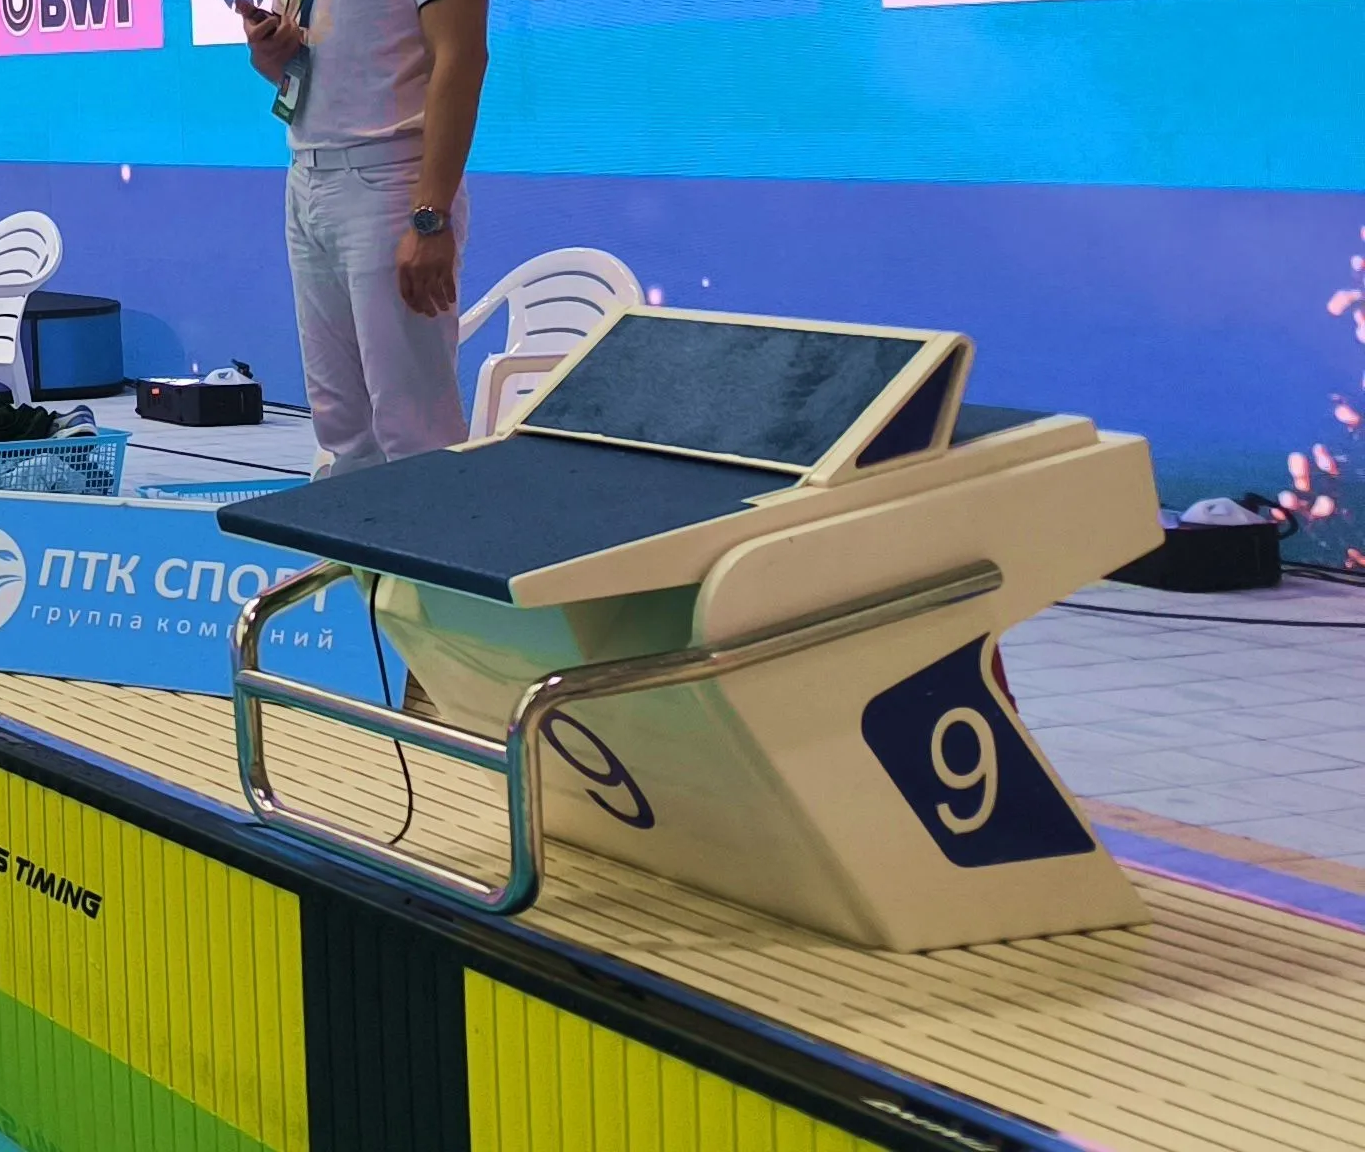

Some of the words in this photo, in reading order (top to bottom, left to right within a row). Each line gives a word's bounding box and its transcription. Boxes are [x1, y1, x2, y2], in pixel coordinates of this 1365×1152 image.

[38, 548, 141, 594] ПТК
[31, 604, 142, 630] группа
[156, 616, 334, 650] комний
[540, 708, 655, 830] 9
[931, 706, 998, 834] 9
[16, 856, 103, 920] TIMING
